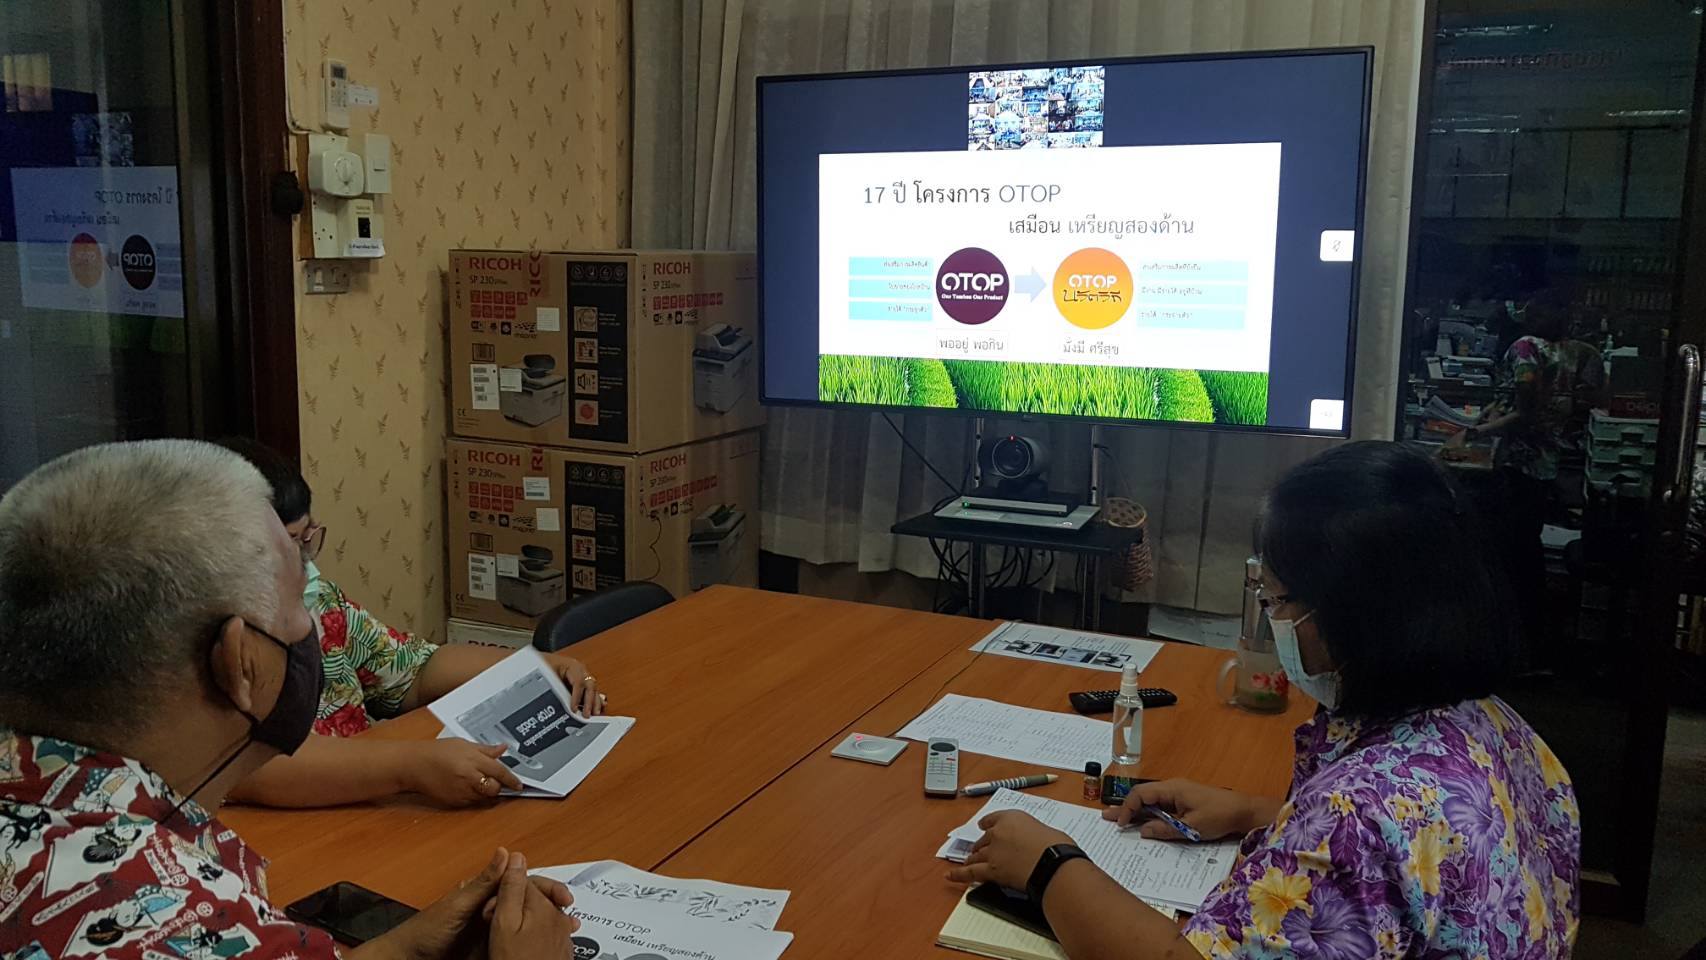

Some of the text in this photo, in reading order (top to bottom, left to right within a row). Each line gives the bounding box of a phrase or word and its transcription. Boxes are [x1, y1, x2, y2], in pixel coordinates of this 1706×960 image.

[863, 180, 1061, 204] 17 ปี โครงการ OTOP
[1008, 212, 1195, 240] เสมือน เหรียญสองด้าน
[469, 256, 522, 271] RICOH
[653, 262, 691, 275] RICOH
[941, 272, 1004, 291] OTOP
[1068, 273, 1117, 289] OTOP
[939, 336, 1004, 354] พออยู่ พอกิน
[467, 449, 521, 466] RICOH
[650, 453, 687, 474] RICOH
[569, 906, 652, 935] โครงการ OTOP
